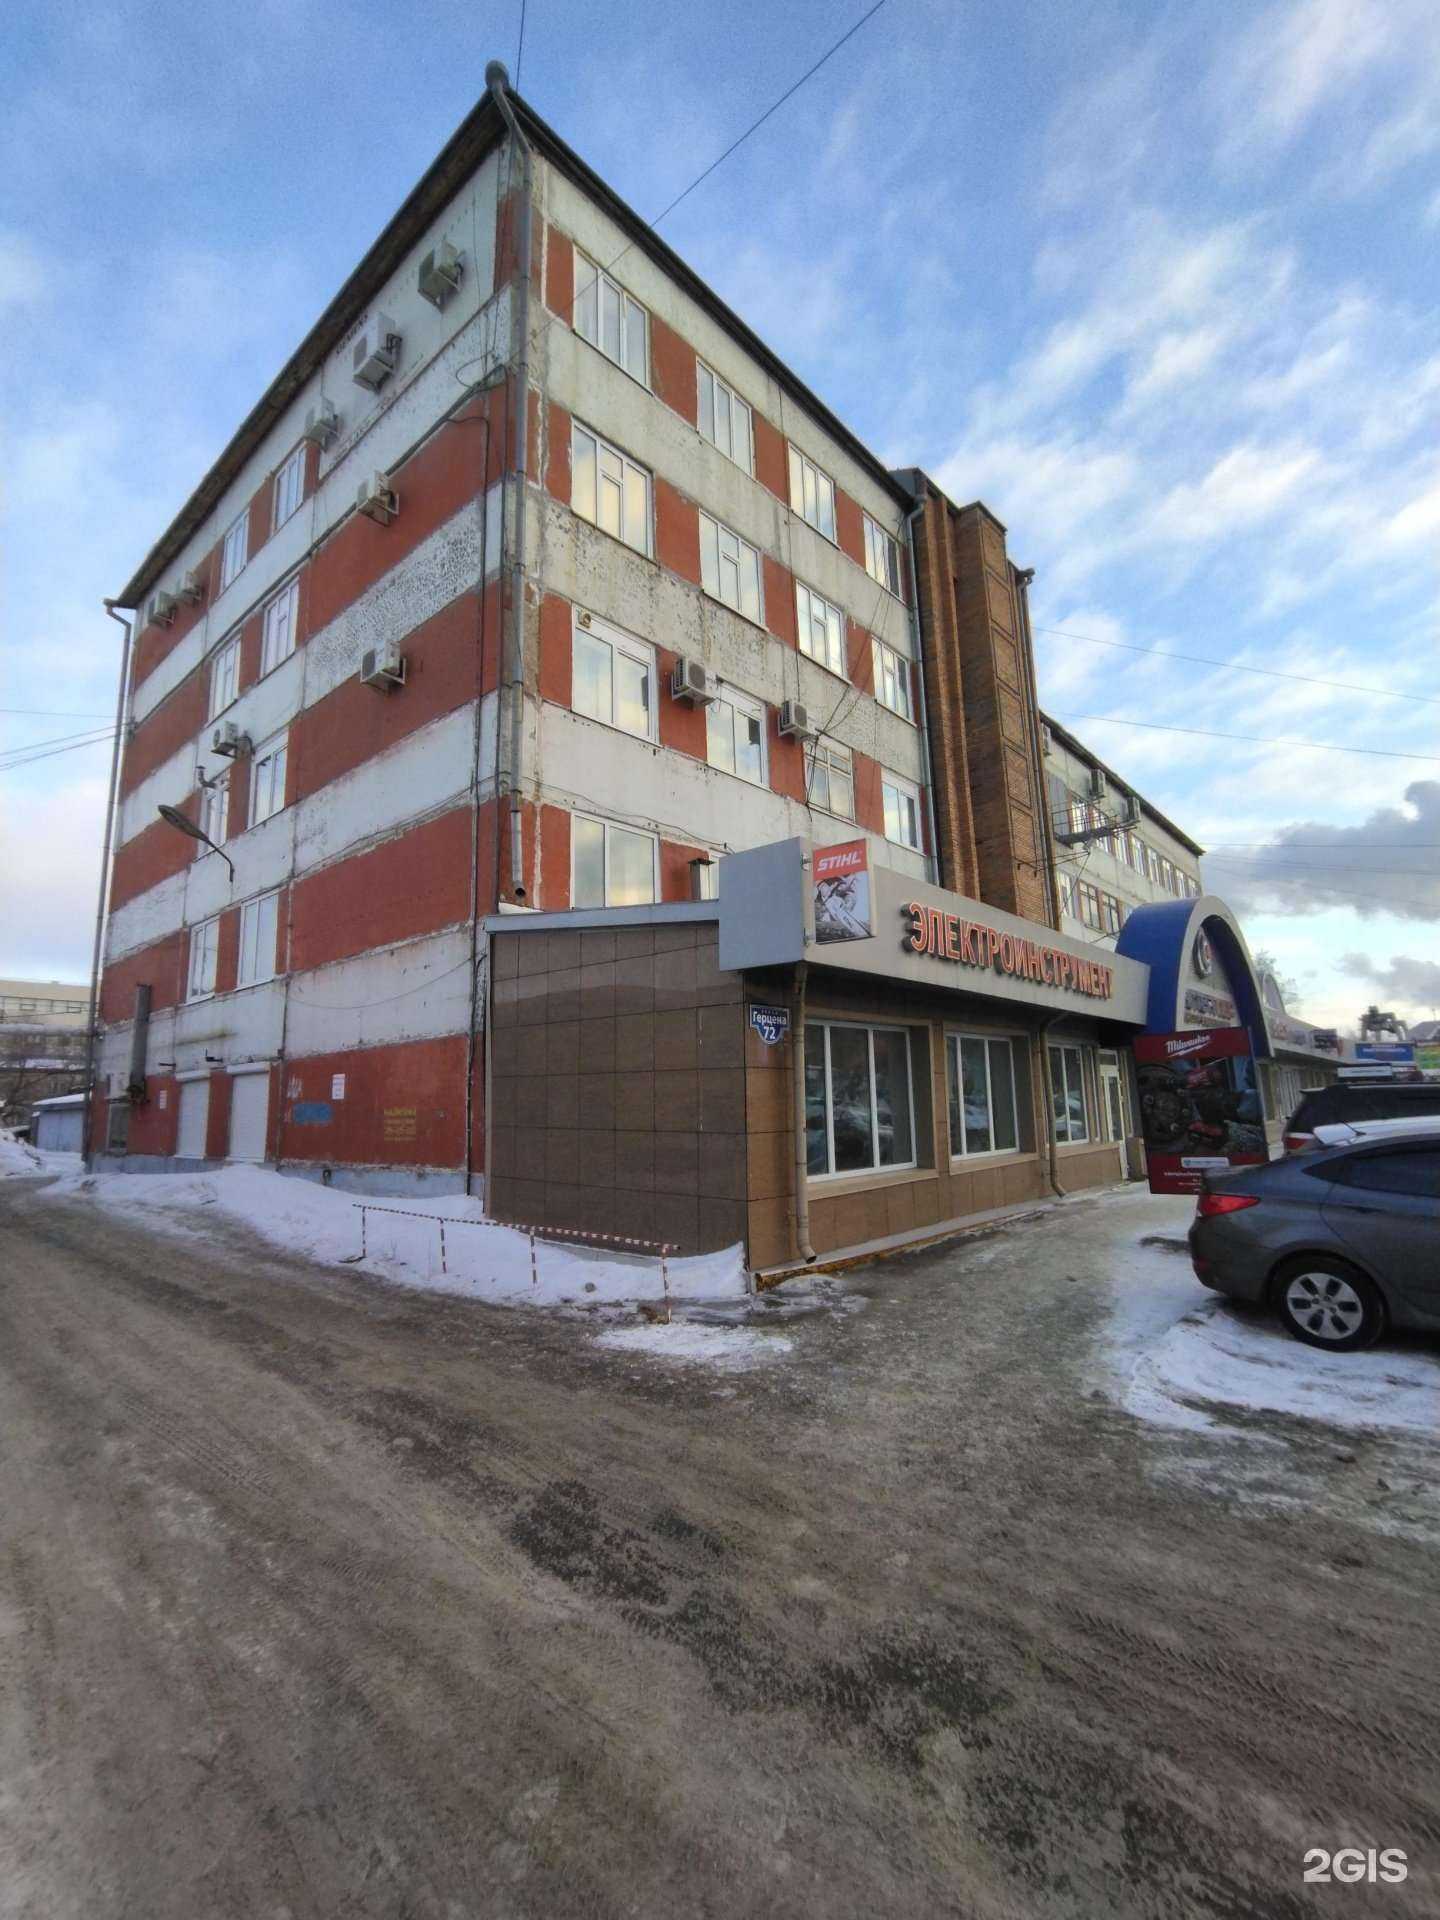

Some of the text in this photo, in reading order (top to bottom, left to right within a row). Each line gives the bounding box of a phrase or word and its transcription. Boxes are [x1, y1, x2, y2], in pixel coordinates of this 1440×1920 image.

[818, 852, 860, 871] STIHL
[908, 901, 1113, 999] ЭЛЕКТРОИНСТРУМЕНТ
[753, 1011, 787, 1026] Герцена
[764, 1026, 776, 1040] 72
